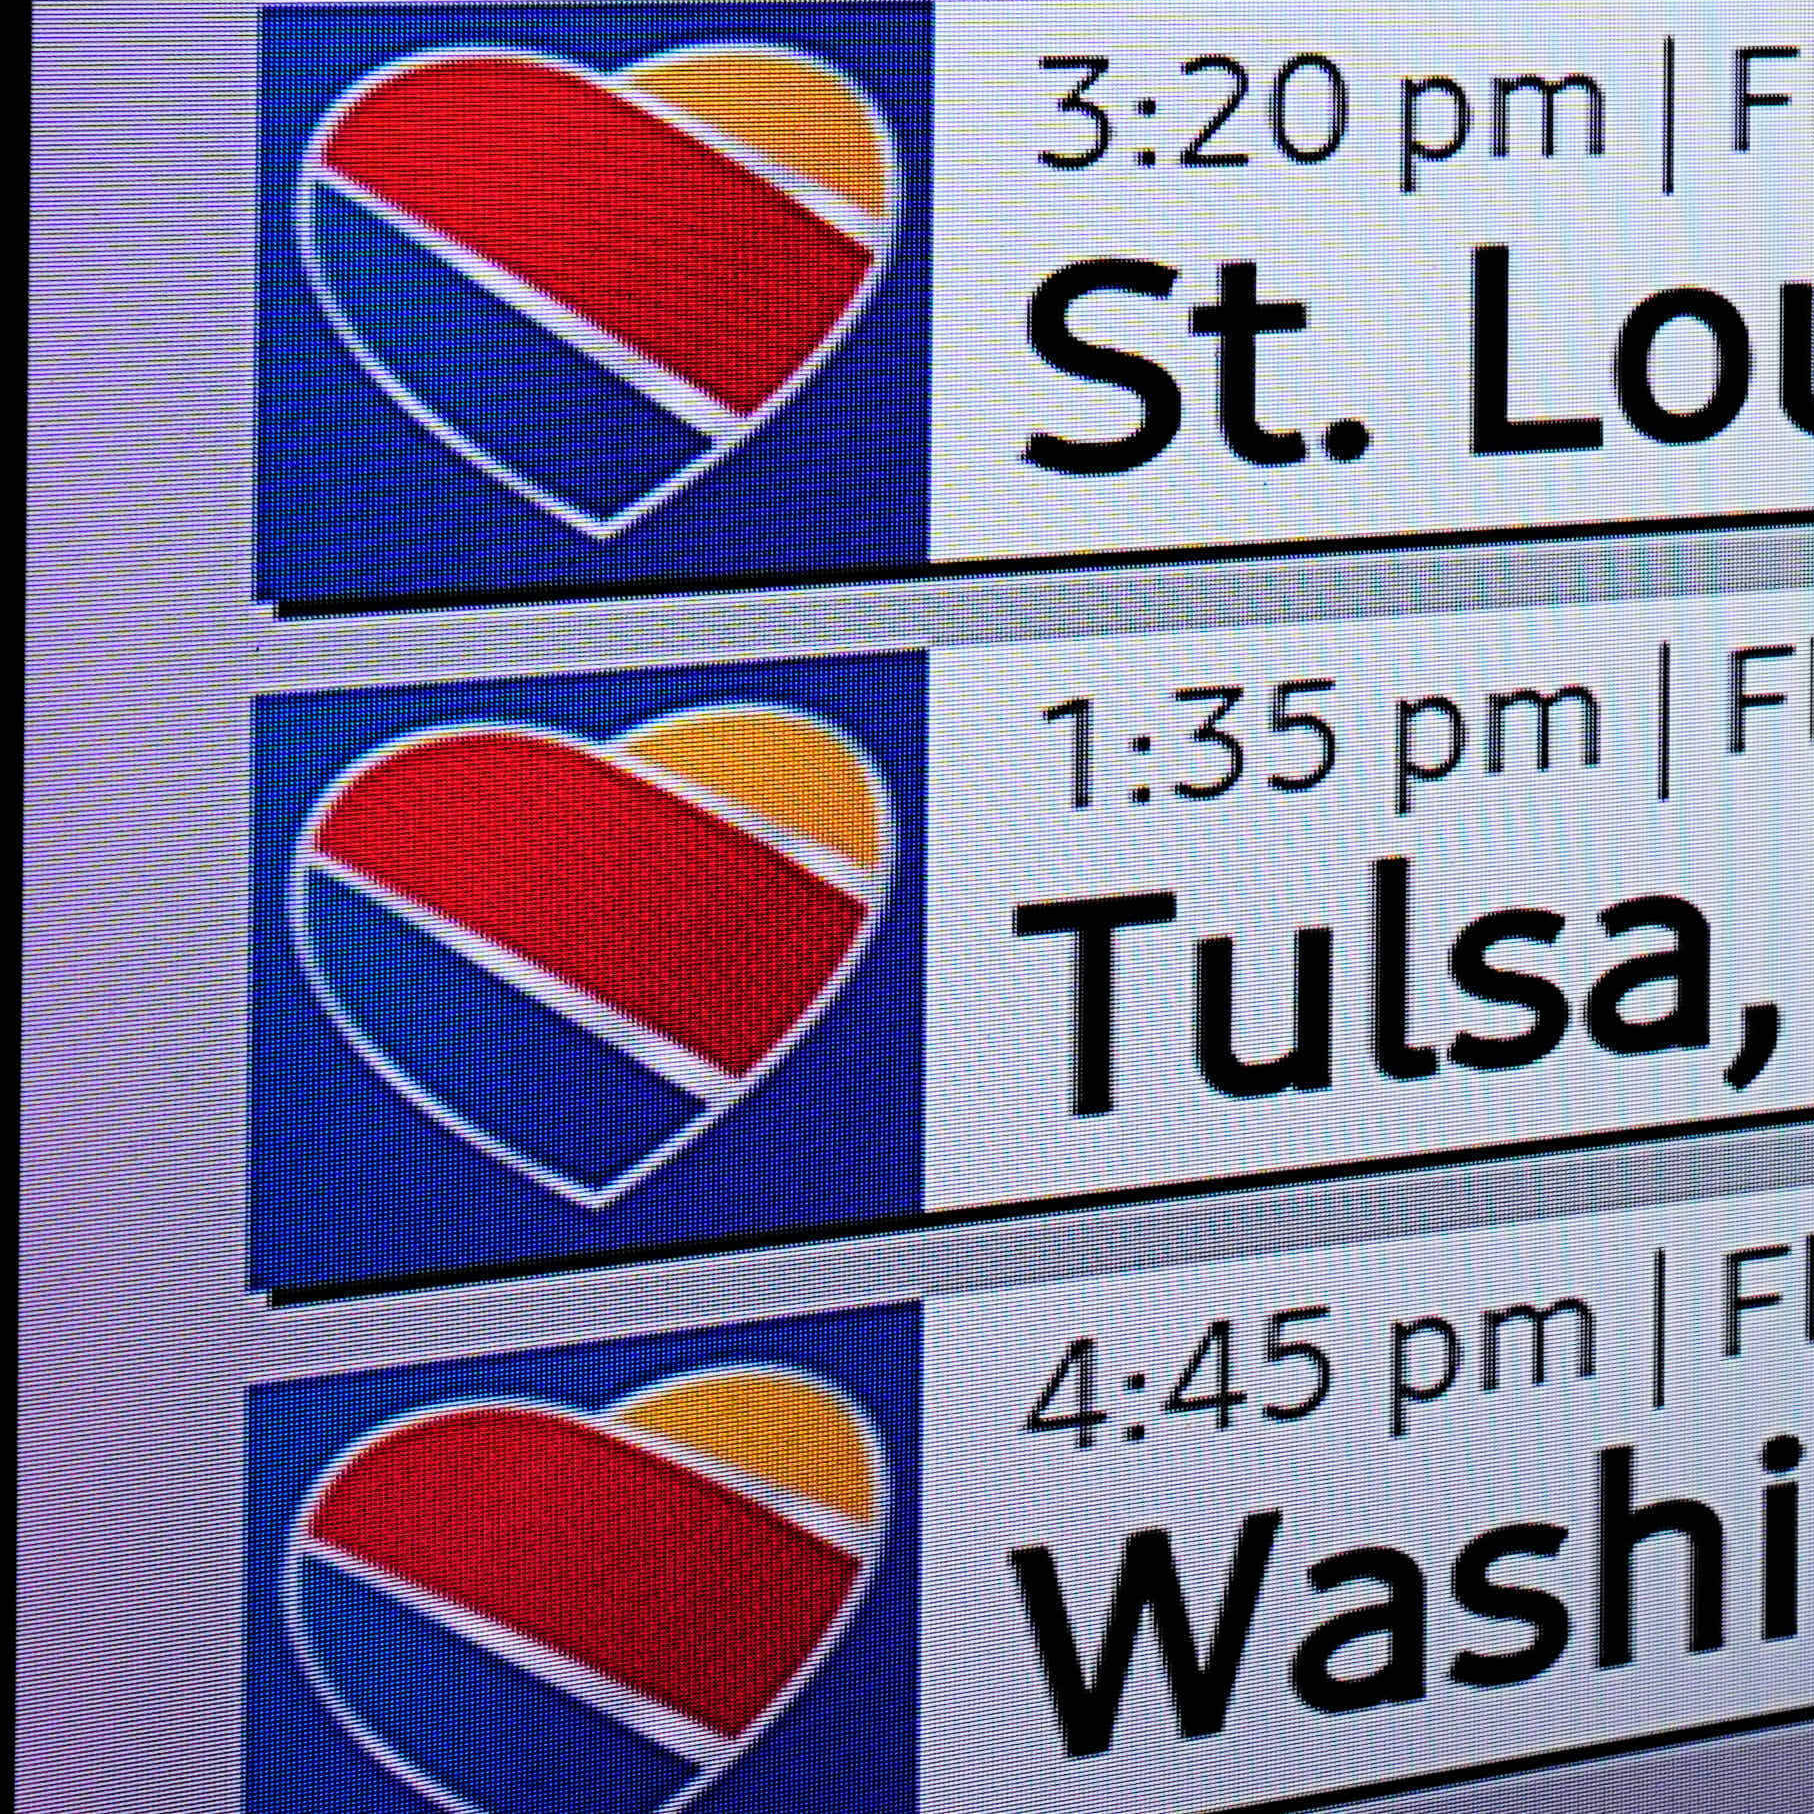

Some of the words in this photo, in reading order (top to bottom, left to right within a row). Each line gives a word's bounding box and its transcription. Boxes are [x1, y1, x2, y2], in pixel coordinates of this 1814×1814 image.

[1038, 53, 1348, 171] 3:20
[1401, 74, 1605, 194] pm
[1021, 258, 1371, 476] St.
[1043, 679, 1337, 809] 1:35
[1396, 685, 1600, 816] pm
[1013, 857, 1781, 1117] Tulsa,
[1024, 1306, 1332, 1449] 4:45
[1390, 1297, 1595, 1438] pm
